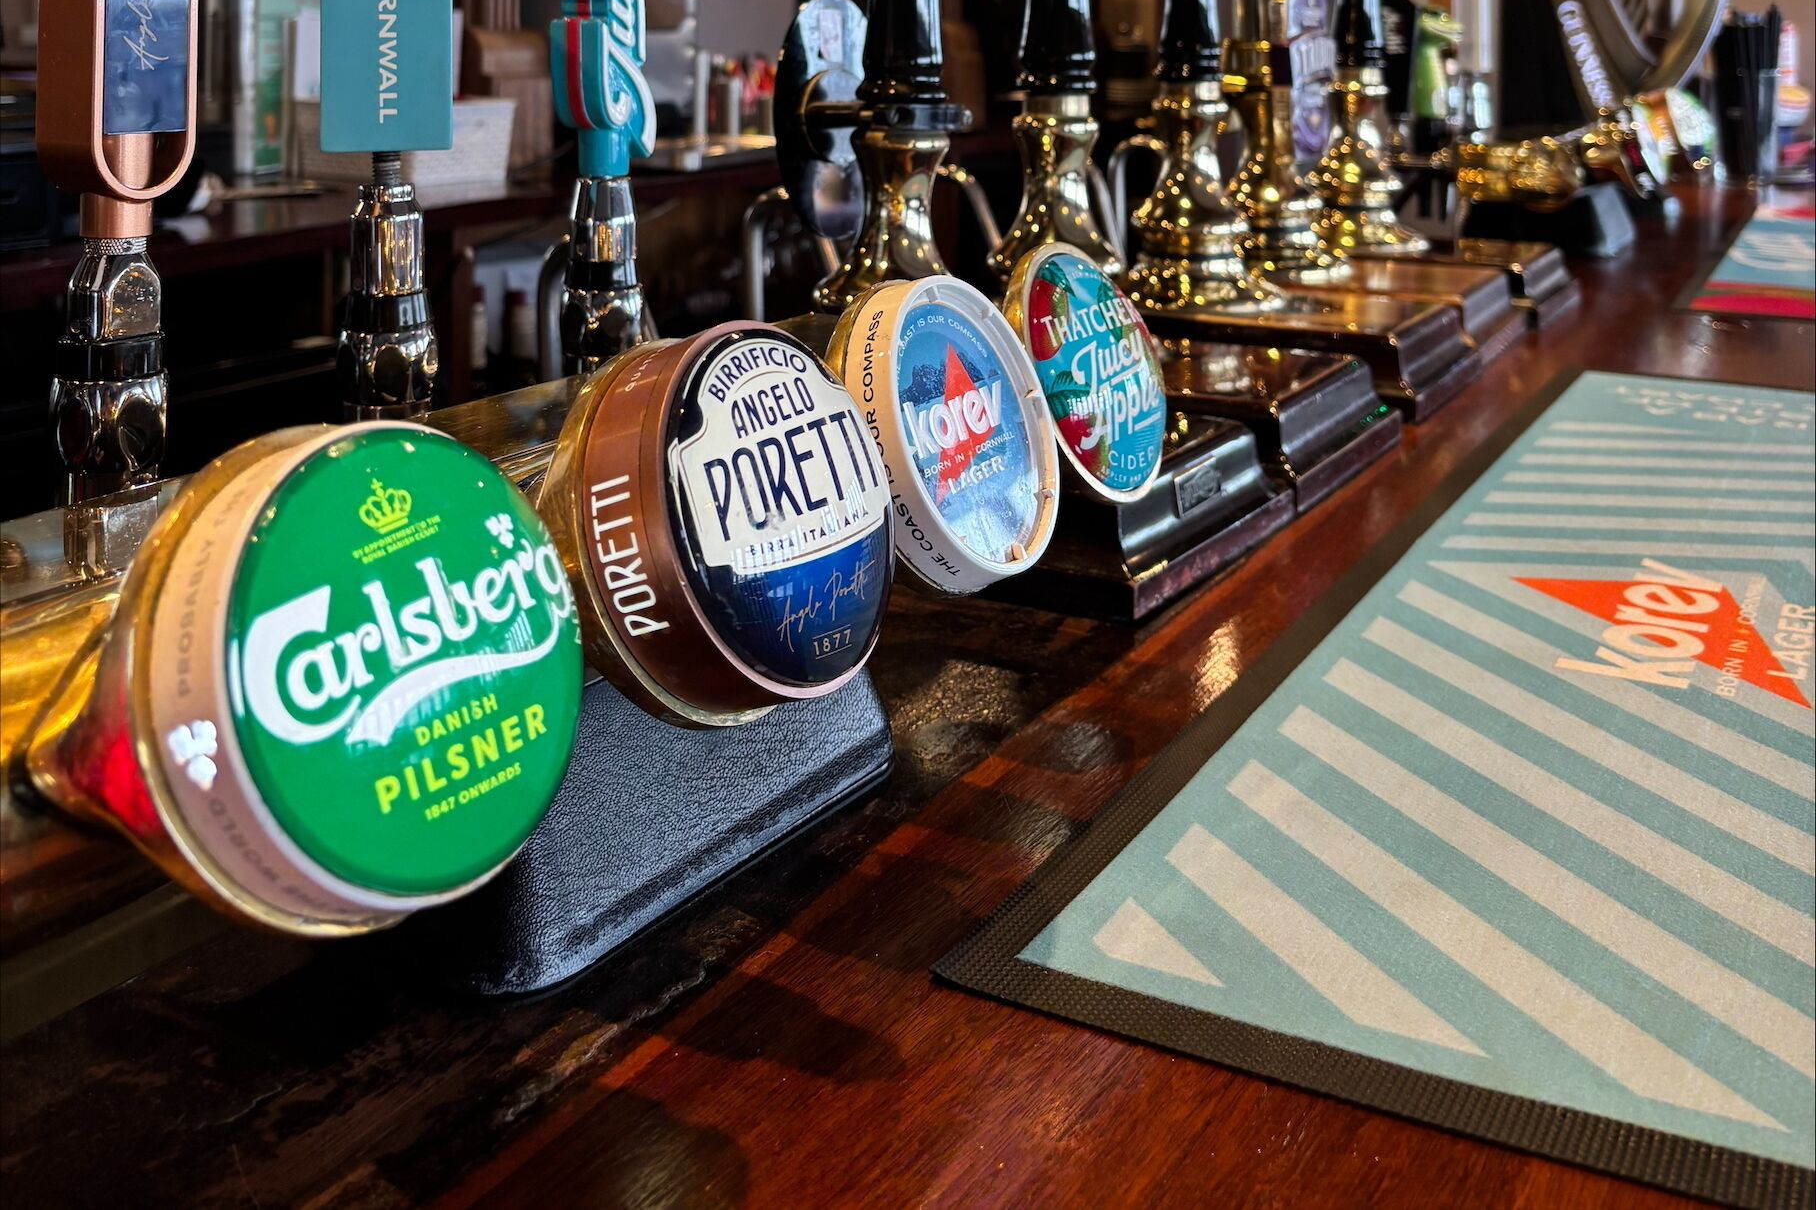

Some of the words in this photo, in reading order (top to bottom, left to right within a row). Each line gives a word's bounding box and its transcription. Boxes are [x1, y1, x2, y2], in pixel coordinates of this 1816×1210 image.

[863, 310, 884, 403] COMPASS
[917, 318, 926, 328] IS
[927, 315, 945, 324] OUR
[948, 319, 987, 358] COMPASS
[1071, 328, 1145, 395] Juicy
[708, 346, 807, 403] BIRRIFICIO
[731, 377, 815, 439] ANGELO
[902, 380, 1002, 460] korev
[703, 409, 878, 542] PORETTI
[924, 460, 951, 479] BORN
[955, 453, 965, 464] IN
[975, 431, 1015, 454] CORNWALL
[947, 455, 1005, 495] LAGER
[749, 536, 796, 556] BIRRA
[891, 493, 933, 552] COAST
[591, 474, 670, 637] PORETTI
[931, 552, 961, 577] THE
[241, 537, 573, 746] Carlsberg
[812, 629, 852, 655] 1877
[1728, 639, 1749, 653] IN
[1765, 602, 1815, 680] LAGER
[1713, 657, 1744, 697] BORN
[415, 693, 498, 746] DANISH
[374, 703, 547, 814] PILSNER
[424, 796, 455, 821] 1847
[458, 762, 522, 804] ONWARDS
